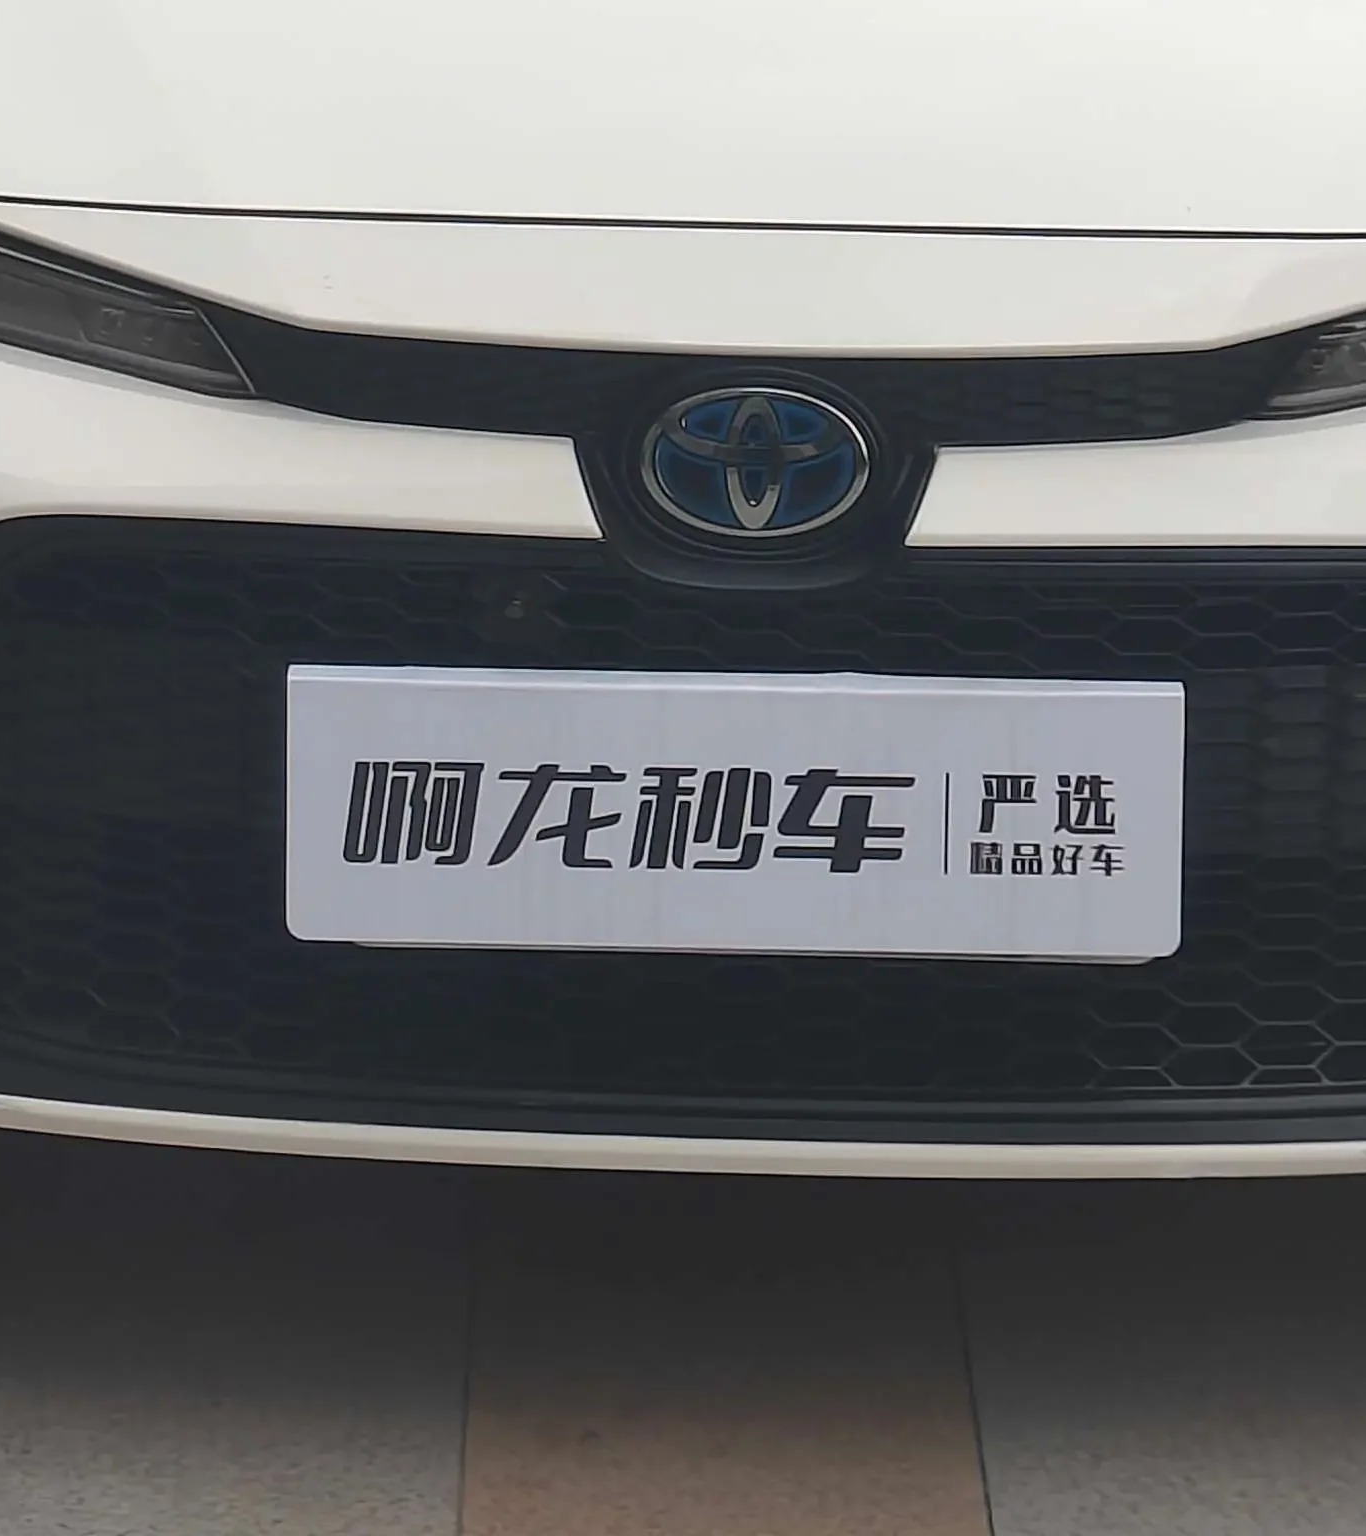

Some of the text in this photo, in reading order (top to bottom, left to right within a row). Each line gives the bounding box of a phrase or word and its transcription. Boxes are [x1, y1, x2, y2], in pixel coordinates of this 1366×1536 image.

[342, 761, 916, 873] 啊龙秒车
[979, 774, 1116, 834] 严选
[970, 841, 1126, 877] 精品好车
